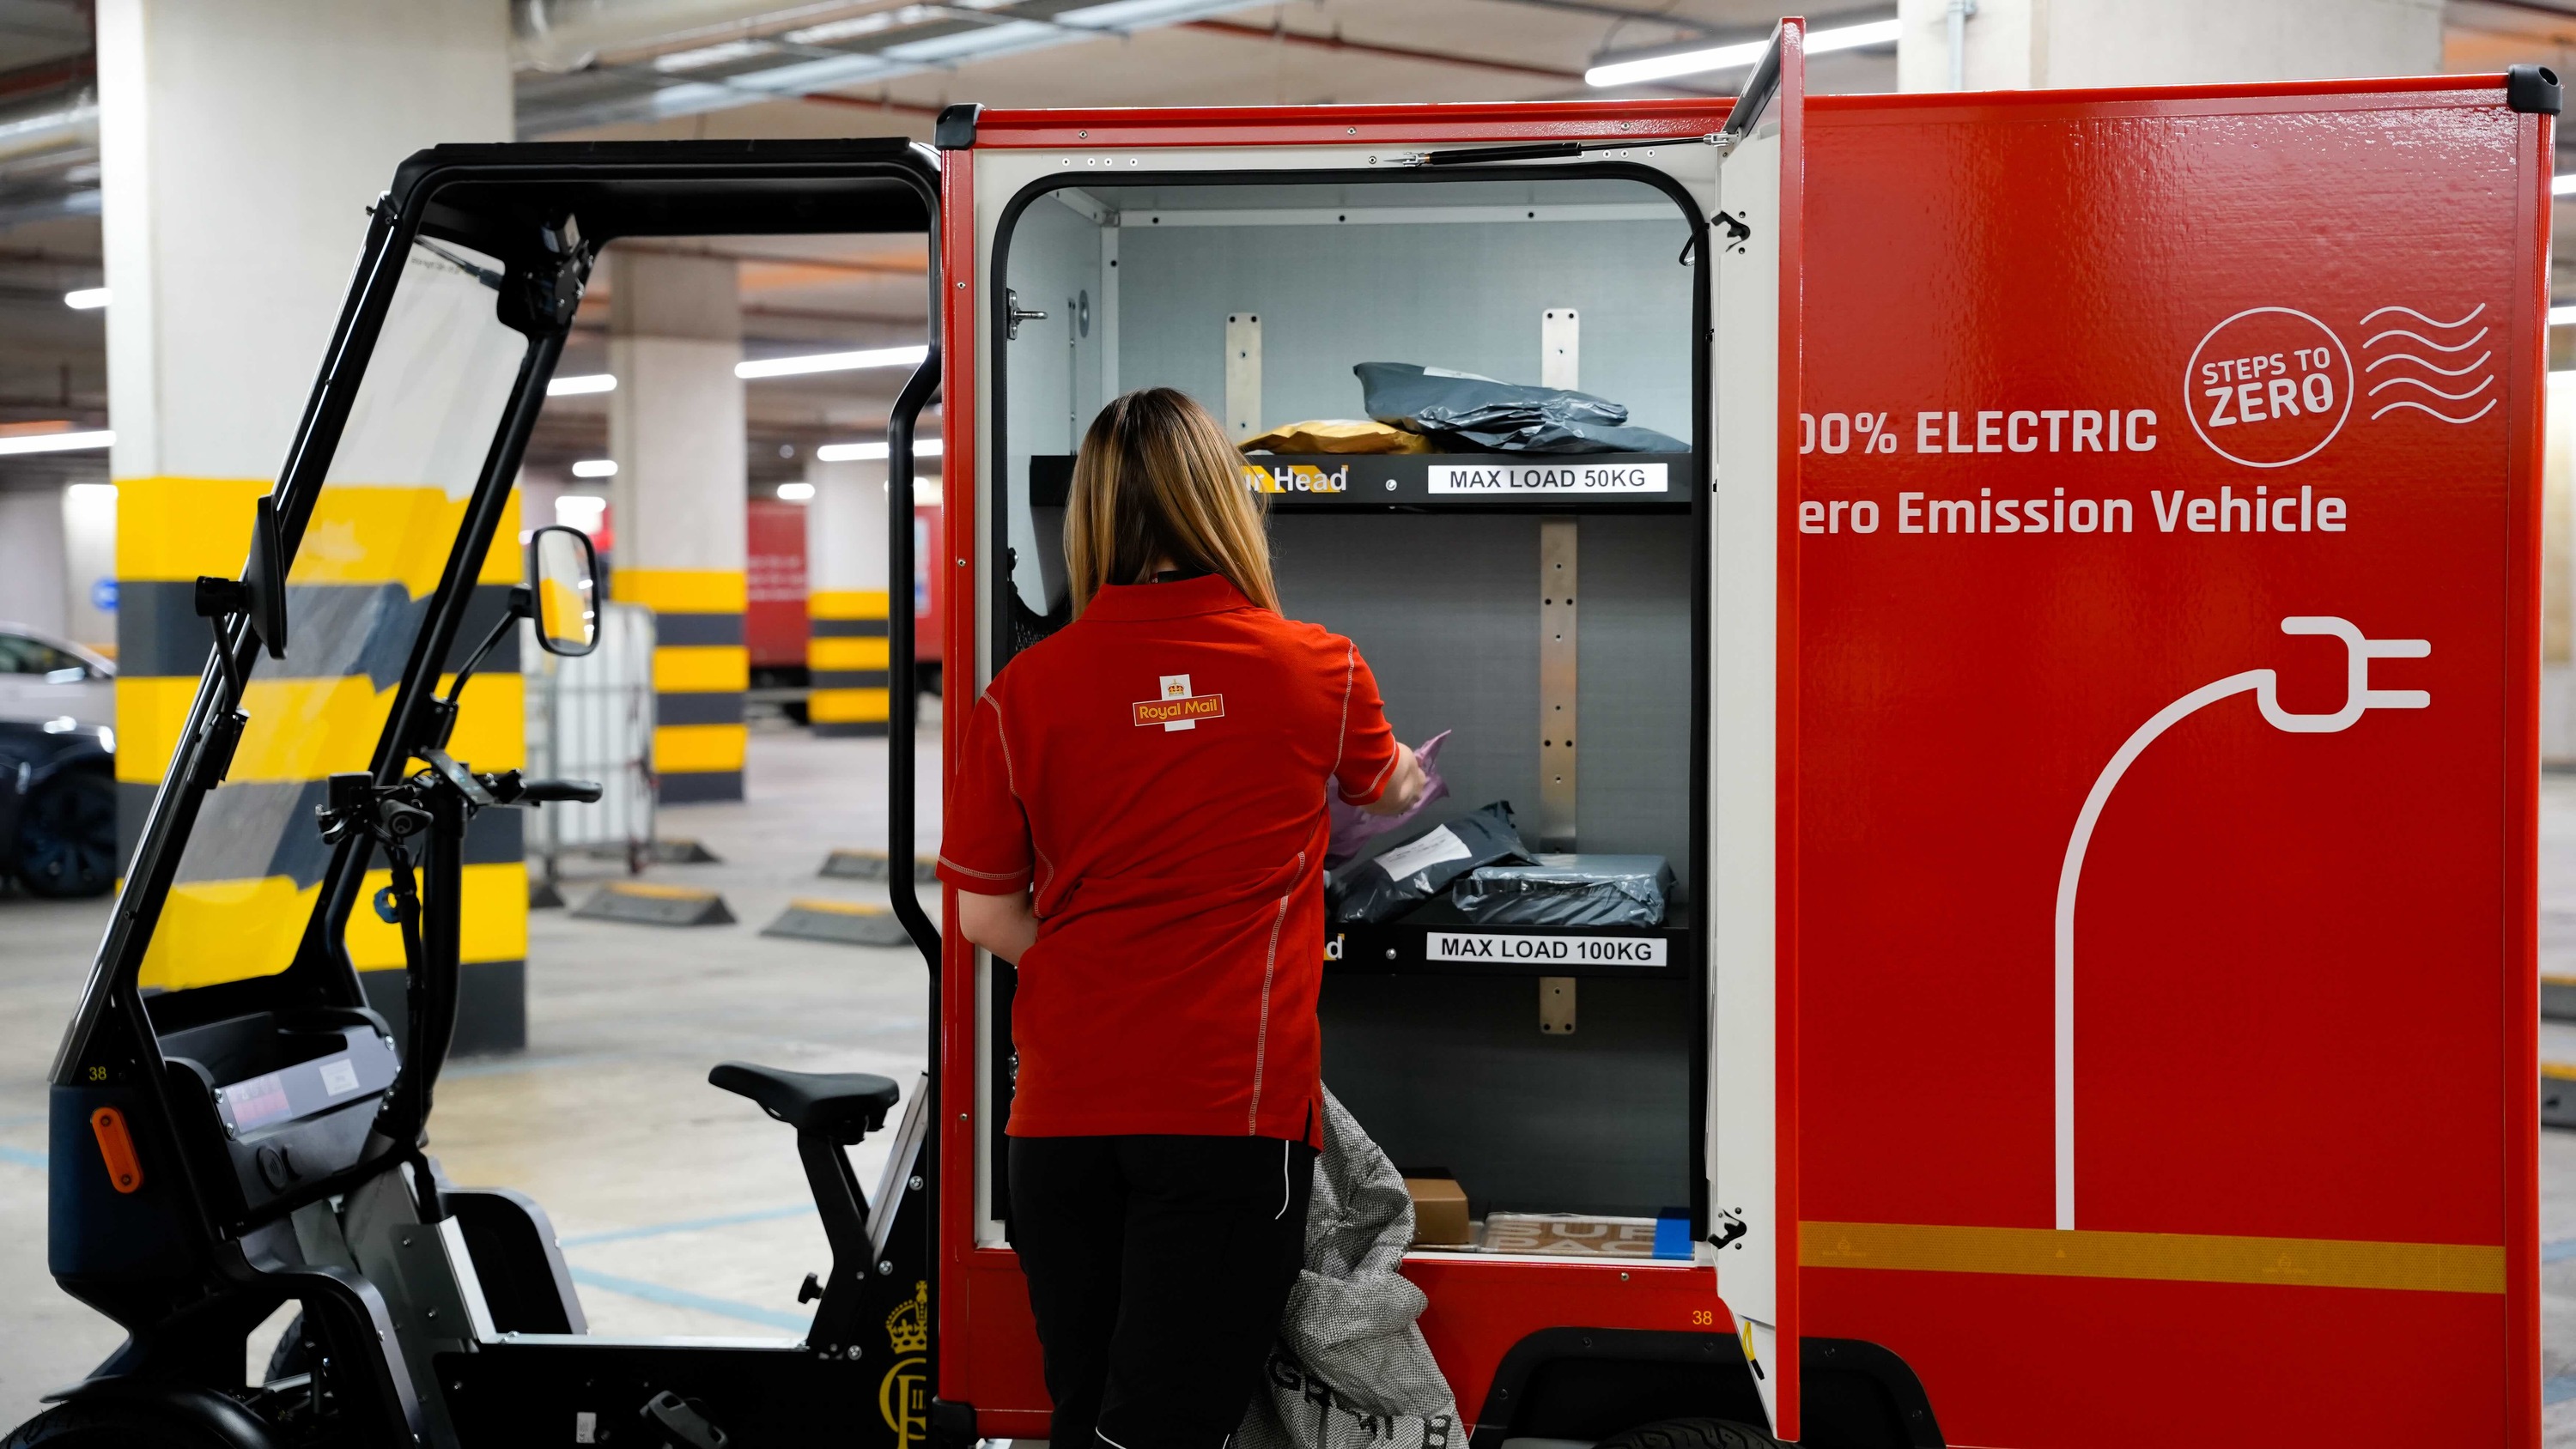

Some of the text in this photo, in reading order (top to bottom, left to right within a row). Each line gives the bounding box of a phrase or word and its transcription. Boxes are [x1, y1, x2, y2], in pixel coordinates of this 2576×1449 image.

[2202, 347, 2330, 385] STEPS TO
[2204, 373, 2334, 427] ZERO
[1799, 409, 2157, 454] 00% ELECTRIC
[1274, 467, 1346, 492] Head
[1449, 469, 1646, 488] MAX LOAD 50KG
[1799, 485, 2347, 534] ero Emission Vehicle
[1139, 699, 1218, 720] Royal Mail
[1441, 937, 1652, 961] MAX LOAD 100KG
[88, 1066, 106, 1081] 38
[1692, 1310, 1712, 1325] 38
